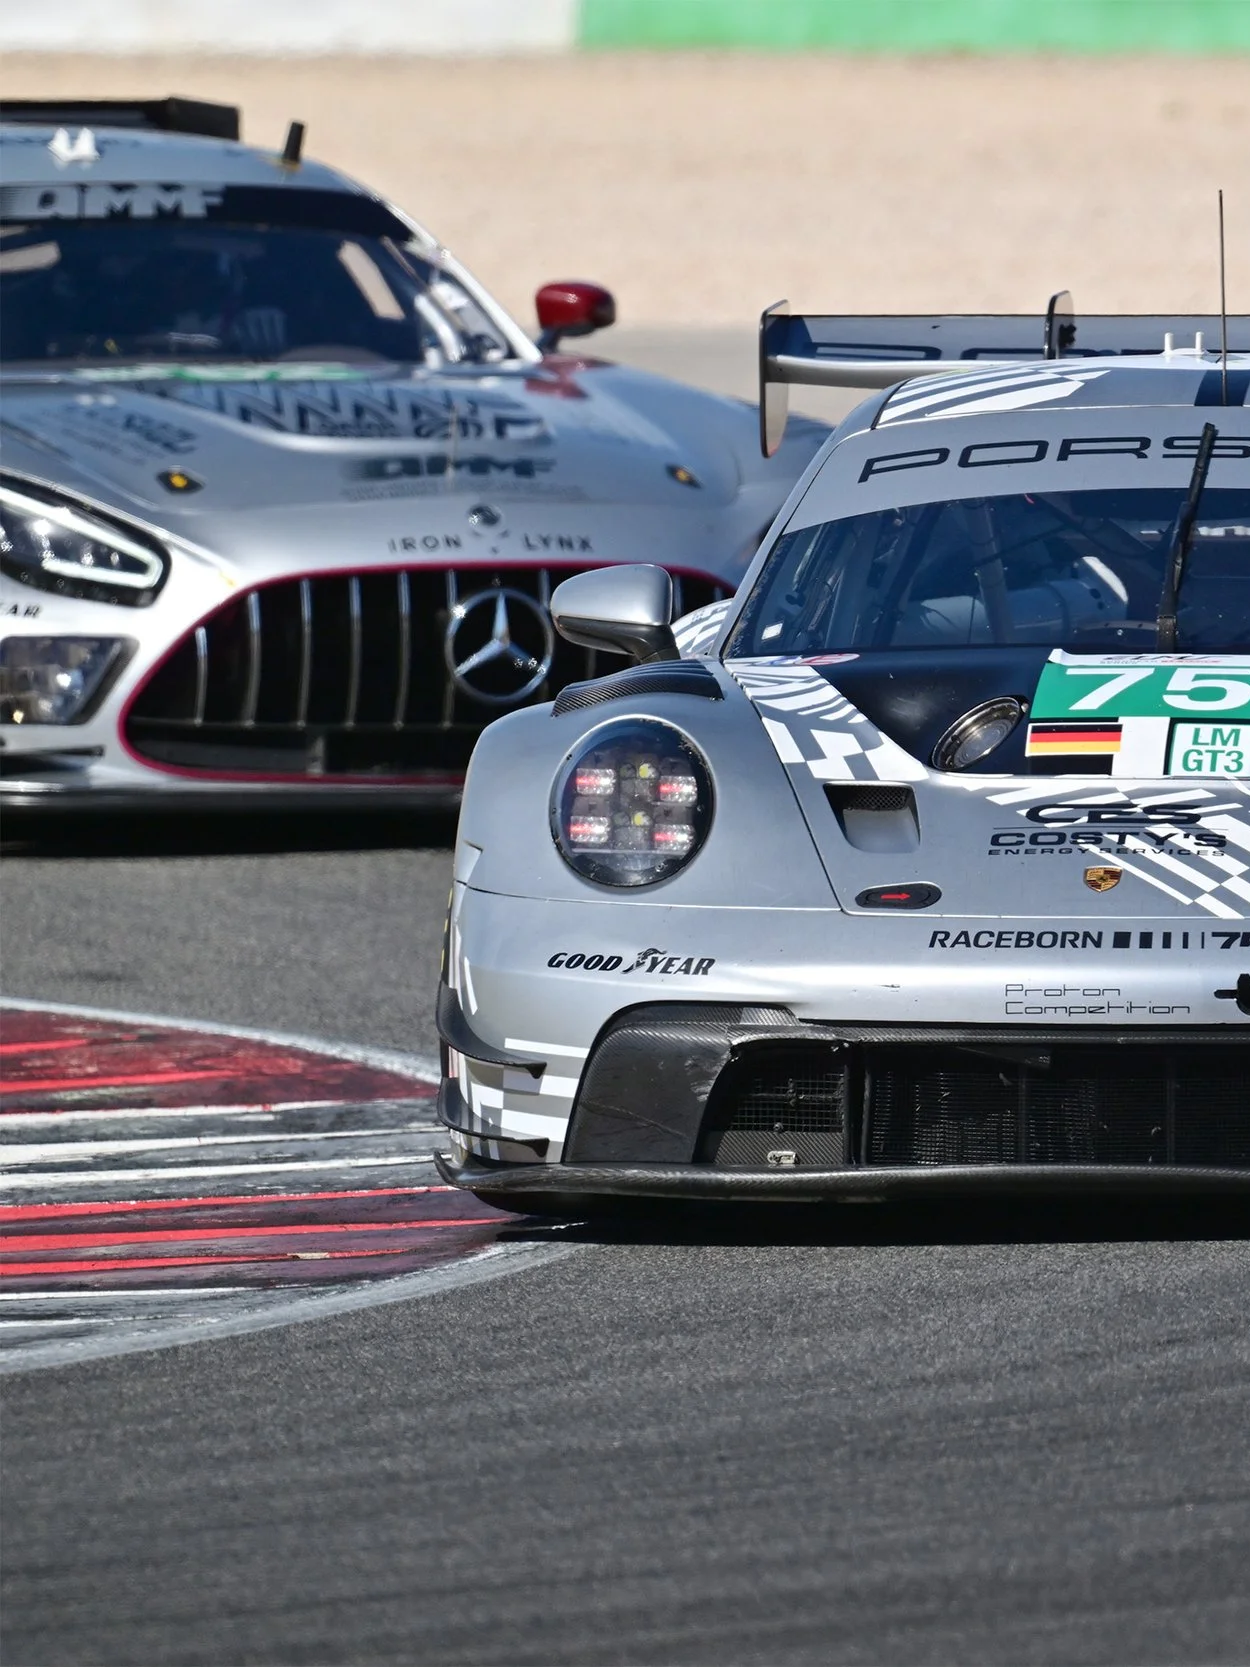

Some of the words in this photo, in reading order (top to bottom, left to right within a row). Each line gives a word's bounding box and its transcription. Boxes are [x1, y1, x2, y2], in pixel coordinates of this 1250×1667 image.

[388, 534, 463, 553] IRON
[523, 534, 595, 552] LYNX
[1191, 727, 1241, 747] LM
[1182, 749, 1244, 773] GT3
[990, 831, 1228, 848] COSTY'S
[987, 847, 1090, 856] ENERGY
[1099, 846, 1226, 857] SERVICES
[928, 930, 1103, 950] RACEBORN
[1005, 983, 1121, 997] Proton
[1005, 1001, 1191, 1018] Competition
